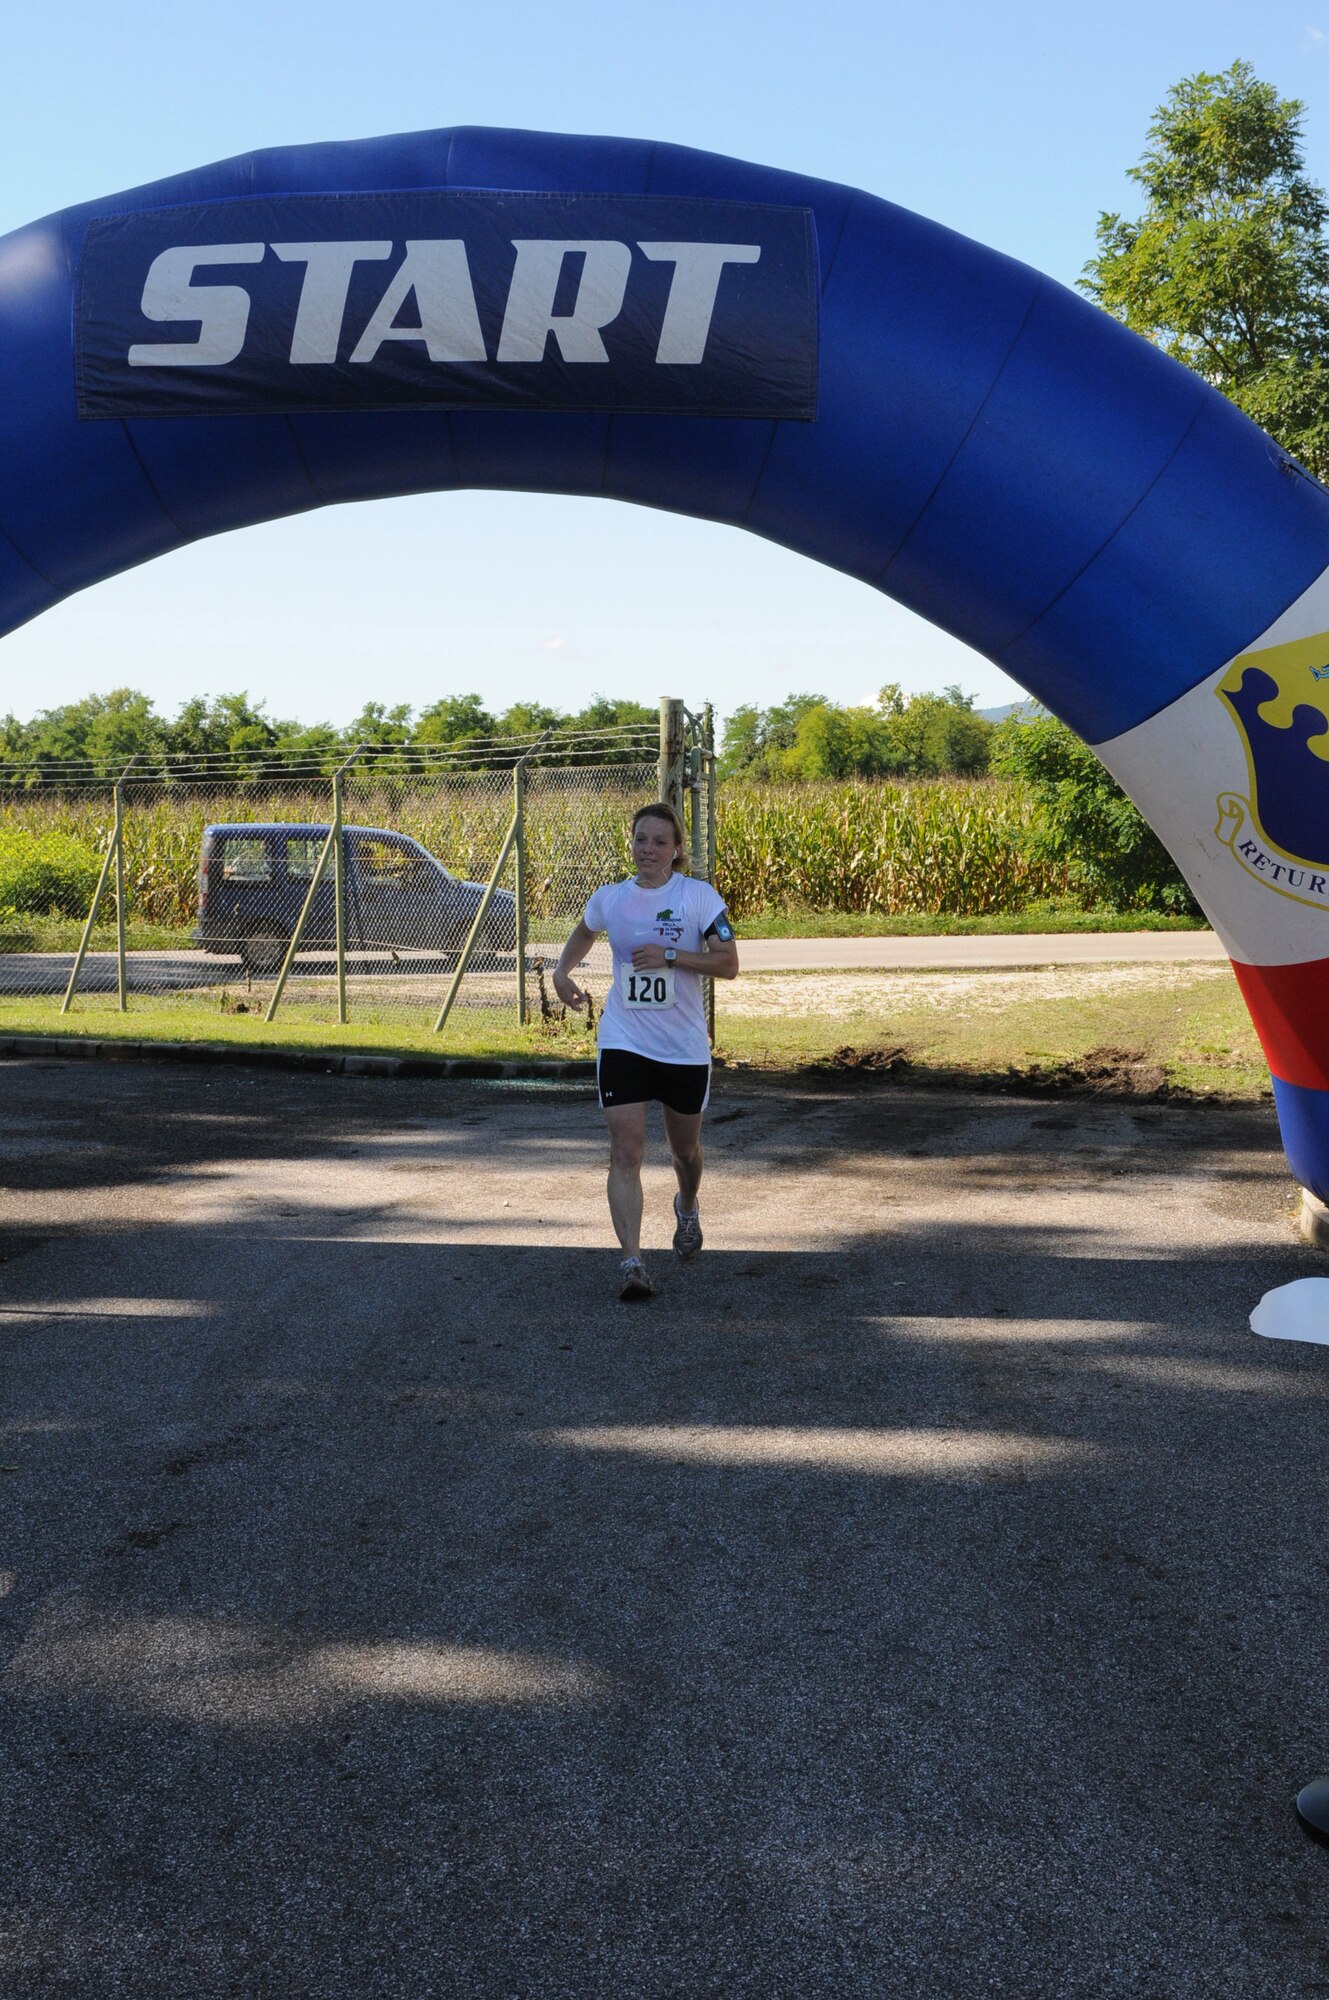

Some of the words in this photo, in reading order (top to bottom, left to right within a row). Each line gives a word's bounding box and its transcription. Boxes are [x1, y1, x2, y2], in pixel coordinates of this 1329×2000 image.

[128, 239, 761, 367] START
[1238, 839, 1329, 896] RETUR
[628, 976, 666, 1003] 120
